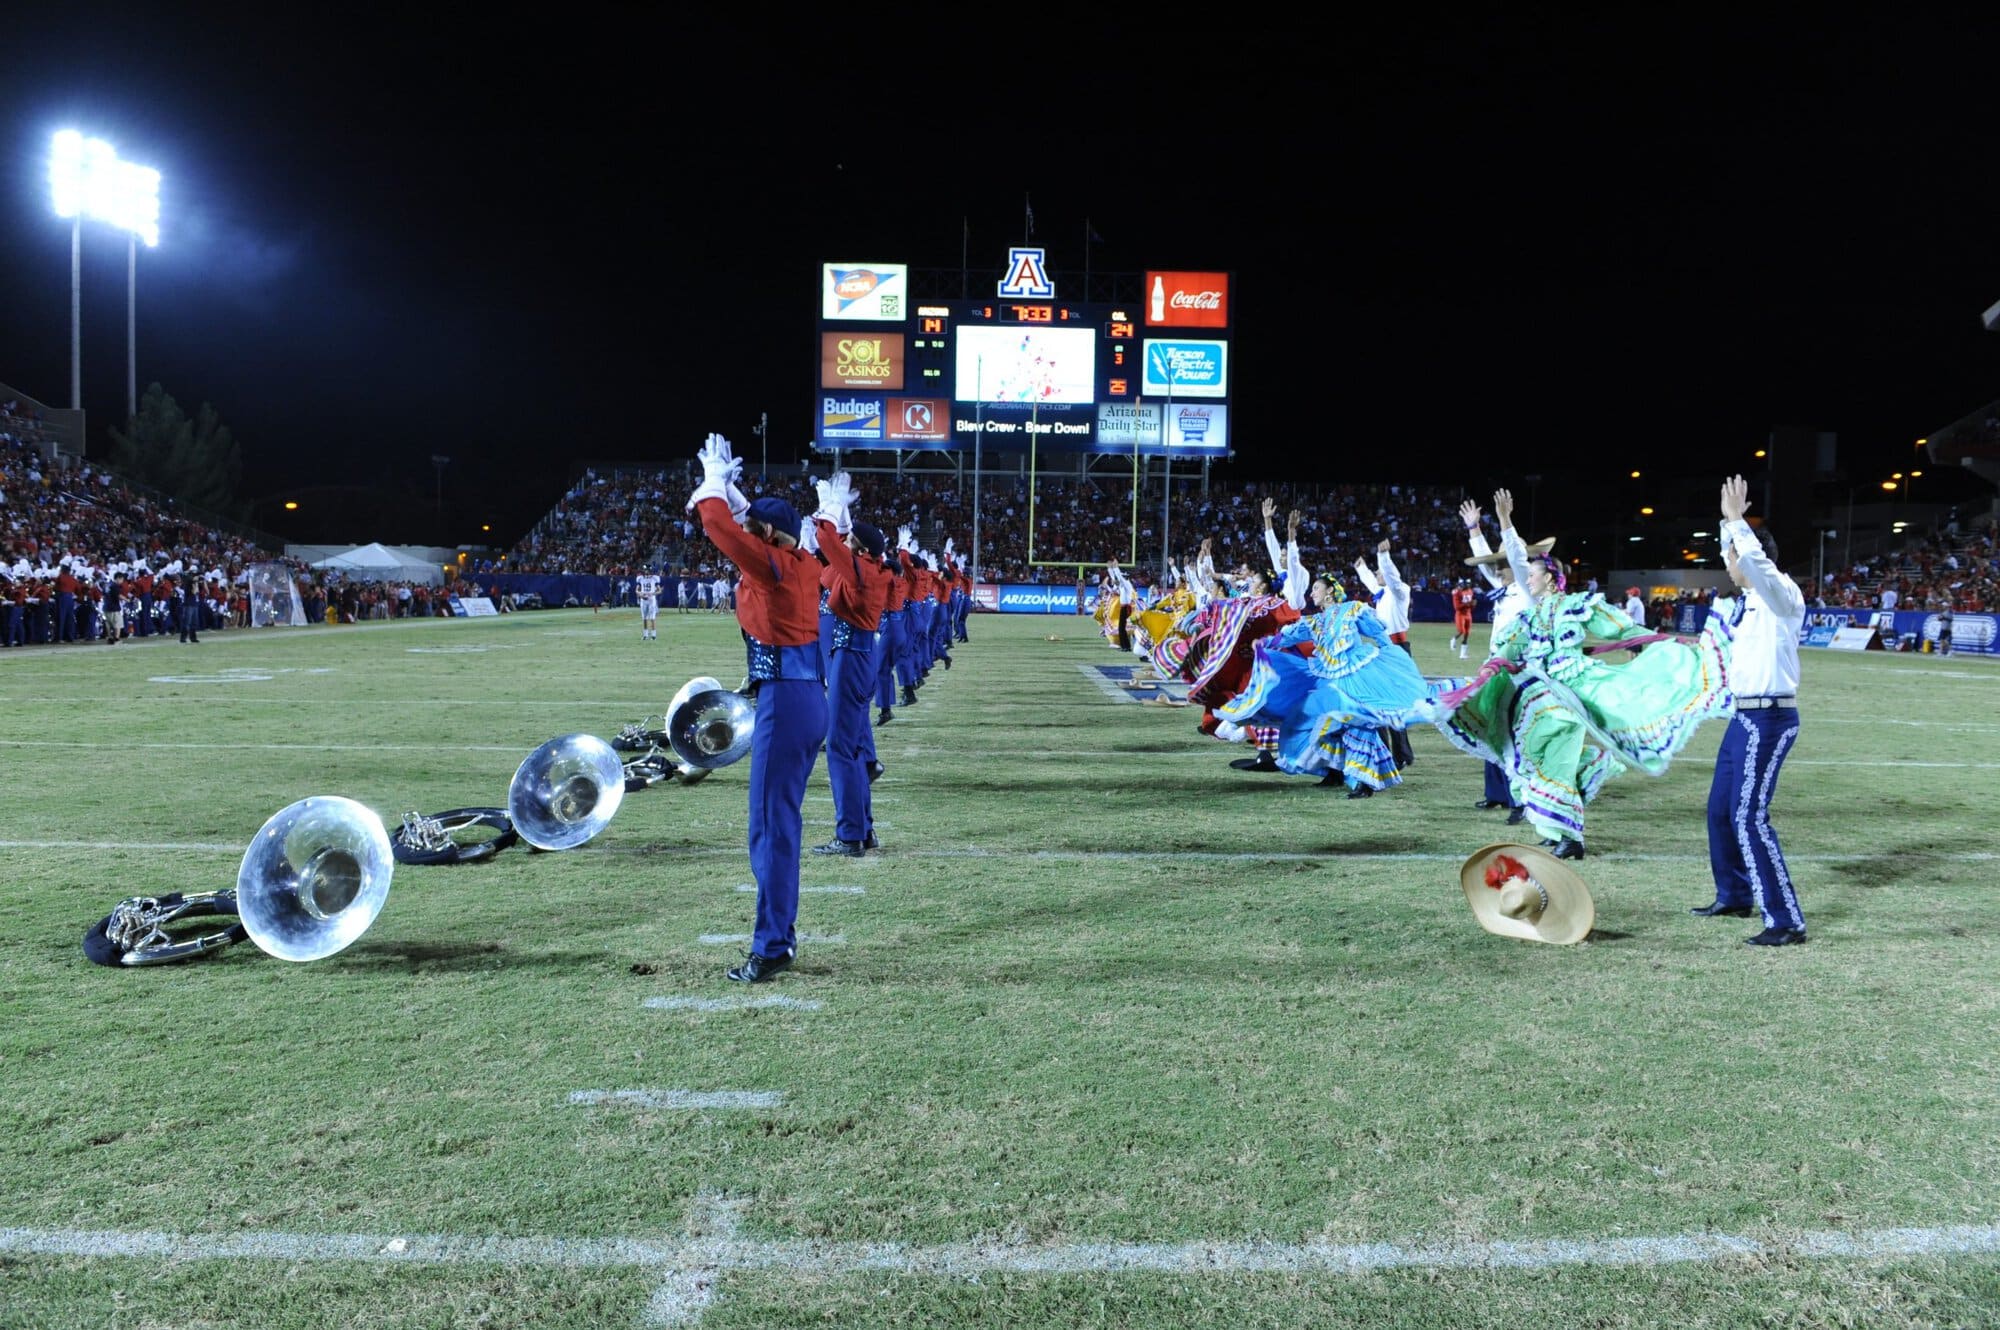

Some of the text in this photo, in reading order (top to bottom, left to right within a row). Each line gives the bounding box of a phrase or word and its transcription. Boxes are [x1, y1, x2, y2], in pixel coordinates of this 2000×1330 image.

[998, 247, 1055, 298] A
[984, 307, 992, 318] 3
[1012, 305, 1052, 322] 7:33
[1060, 309, 1069, 320] 3
[1111, 323, 1134, 337] 24
[837, 339, 890, 365] SOL
[1166, 347, 1205, 360] Tucson
[1115, 353, 1123, 365] 3
[1170, 359, 1216, 370] Electric
[836, 365, 890, 377] CASINOS
[1174, 369, 1216, 380] Power
[824, 398, 880, 419] Budget
[1106, 405, 1153, 418] Arizona
[907, 405, 931, 430] K
[986, 421, 1016, 433] Crew
[1054, 422, 1089, 434] Down!
[1098, 419, 1159, 433] Daily Star
